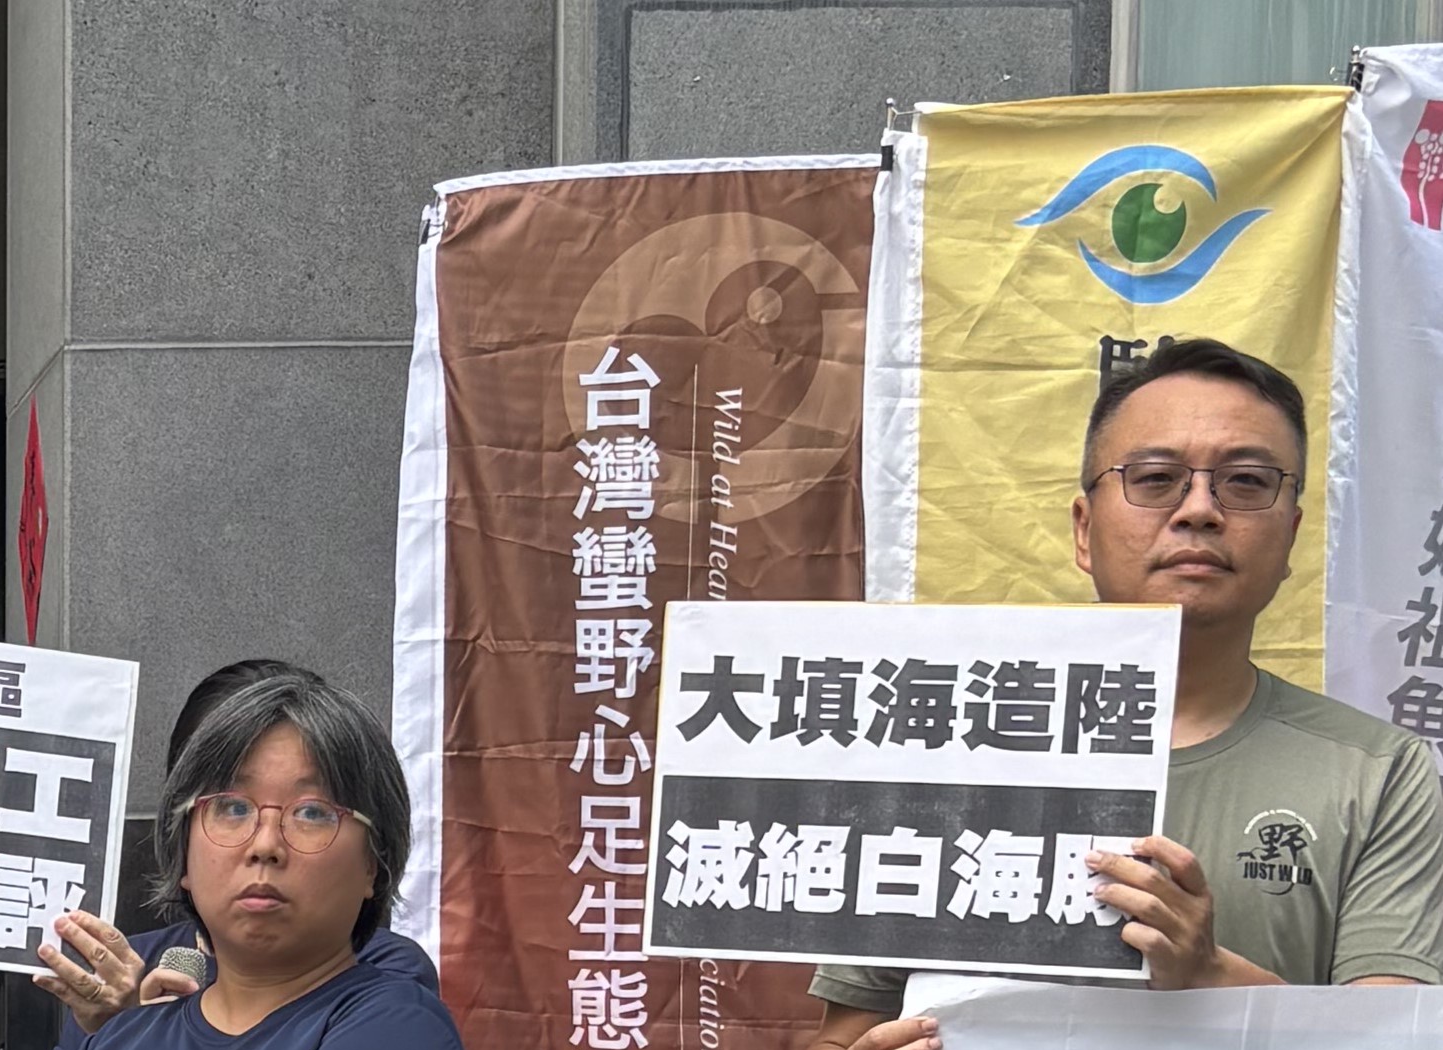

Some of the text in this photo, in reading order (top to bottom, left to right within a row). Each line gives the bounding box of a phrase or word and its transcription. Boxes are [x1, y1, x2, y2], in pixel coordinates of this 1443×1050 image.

[712, 387, 743, 465] Wild
[710, 474, 735, 509] at
[676, 655, 1156, 754] 大填海造陸
[1243, 861, 1313, 886] JUST WILD
